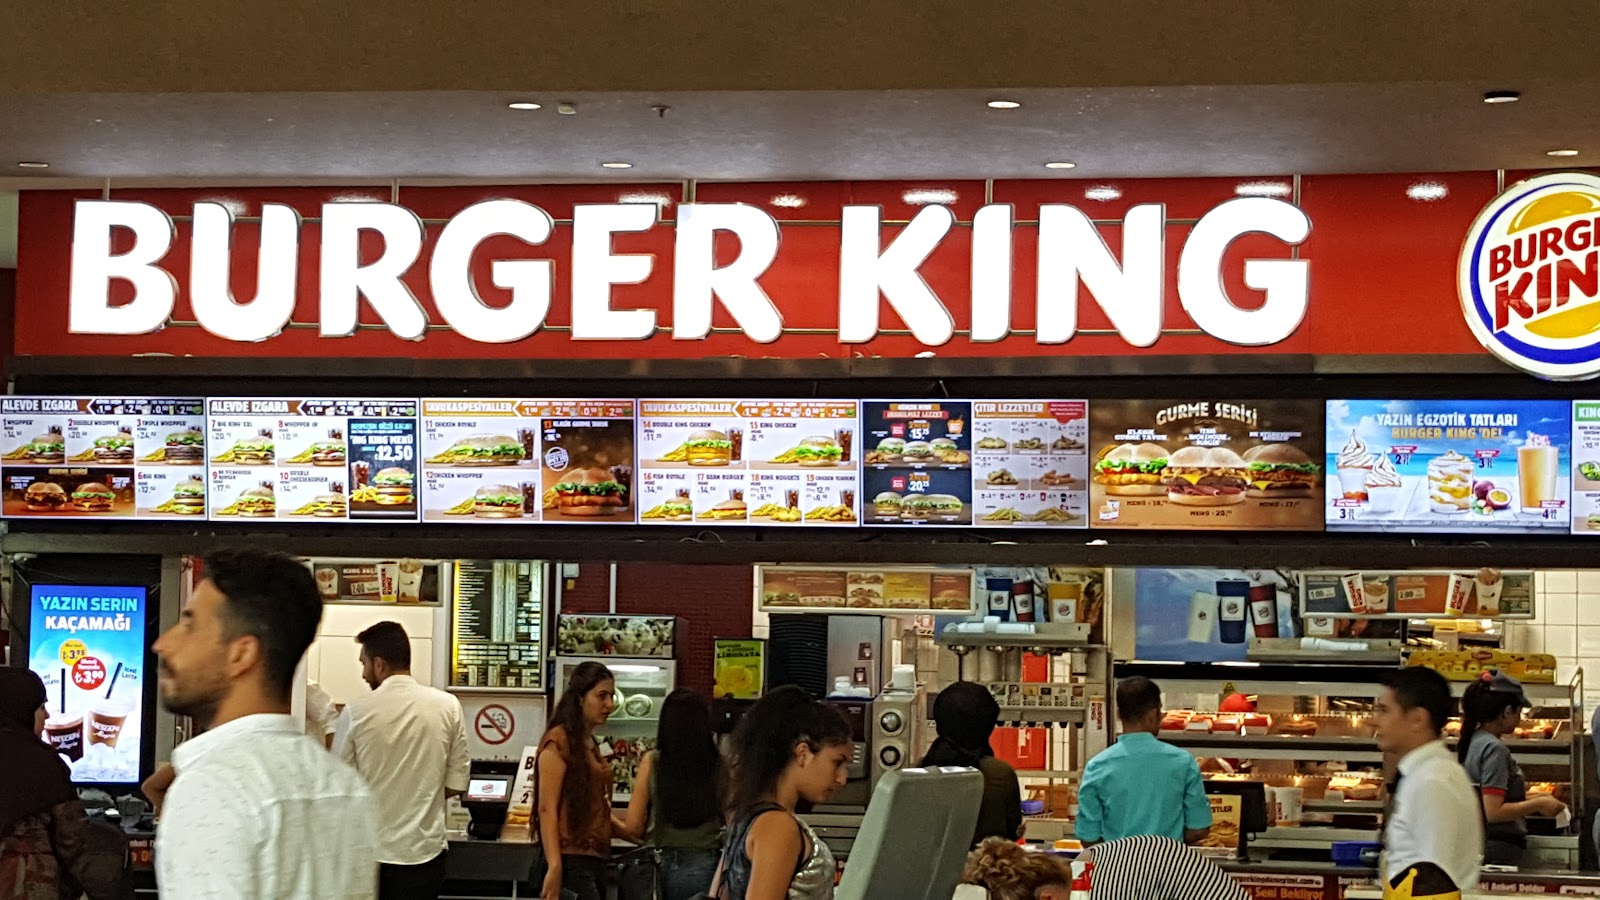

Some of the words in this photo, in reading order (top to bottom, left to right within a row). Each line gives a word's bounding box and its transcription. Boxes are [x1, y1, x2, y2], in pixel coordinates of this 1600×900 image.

[1489, 216, 1600, 283] BURG
[67, 199, 783, 344] BURGER
[837, 196, 1312, 347] KING
[1495, 250, 1599, 331] KIN
[2, 400, 39, 411] ALEVDE
[41, 400, 79, 411] IZGARA
[211, 401, 250, 413] ALEVDE
[252, 401, 289, 413] IZGARA
[1156, 402, 1209, 427] GURME
[1215, 402, 1258, 427] SERİSİ
[1377, 414, 1412, 426] YAZIN
[1417, 412, 1466, 427] EGZOTİK
[1470, 414, 1518, 427] TATLARI
[137, 419, 142, 427] 3
[211, 420, 216, 428] 7
[278, 420, 283, 428] 8
[1392, 428, 1442, 439] BURGER
[1447, 428, 1476, 439] KING
[1395, 454, 1401, 465] 2
[1478, 457, 1485, 468] 3
[212, 472, 218, 480] 9
[806, 474, 814, 482] 19
[1339, 508, 1346, 518] 3
[1542, 510, 1549, 519] 4
[40, 596, 88, 611] YAZIN
[45, 614, 130, 633] KAÇAMAĞI
[1255, 887, 1277, 897] Seni
